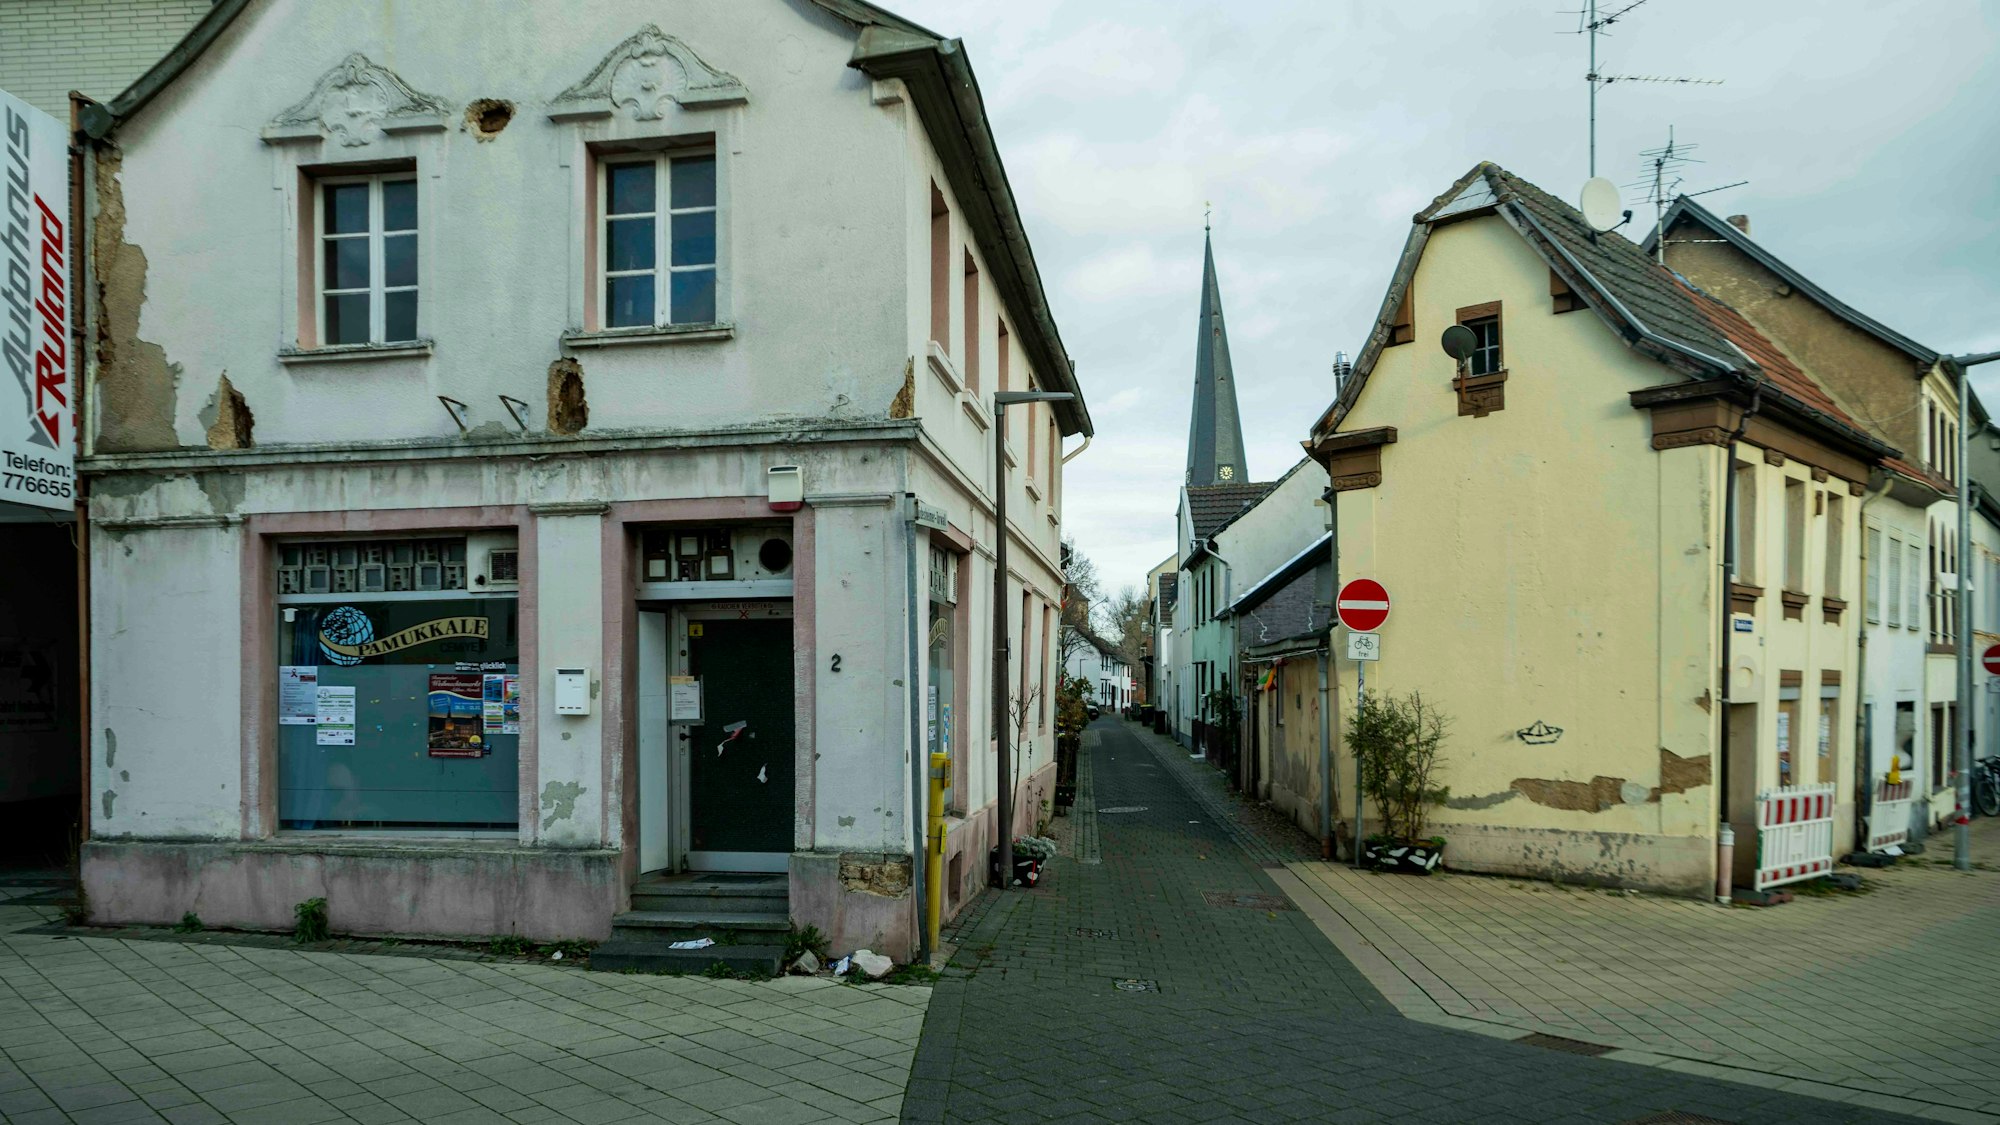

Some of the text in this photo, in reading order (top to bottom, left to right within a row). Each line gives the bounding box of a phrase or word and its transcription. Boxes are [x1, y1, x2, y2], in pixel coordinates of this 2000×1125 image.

[0, 104, 34, 414] Autohaus
[33, 190, 67, 412] Ruland
[2, 450, 71, 478] Telefon:
[2, 472, 71, 498] 776655
[358, 618, 487, 655] PAMUKKALE
[831, 653, 841, 672] 2
